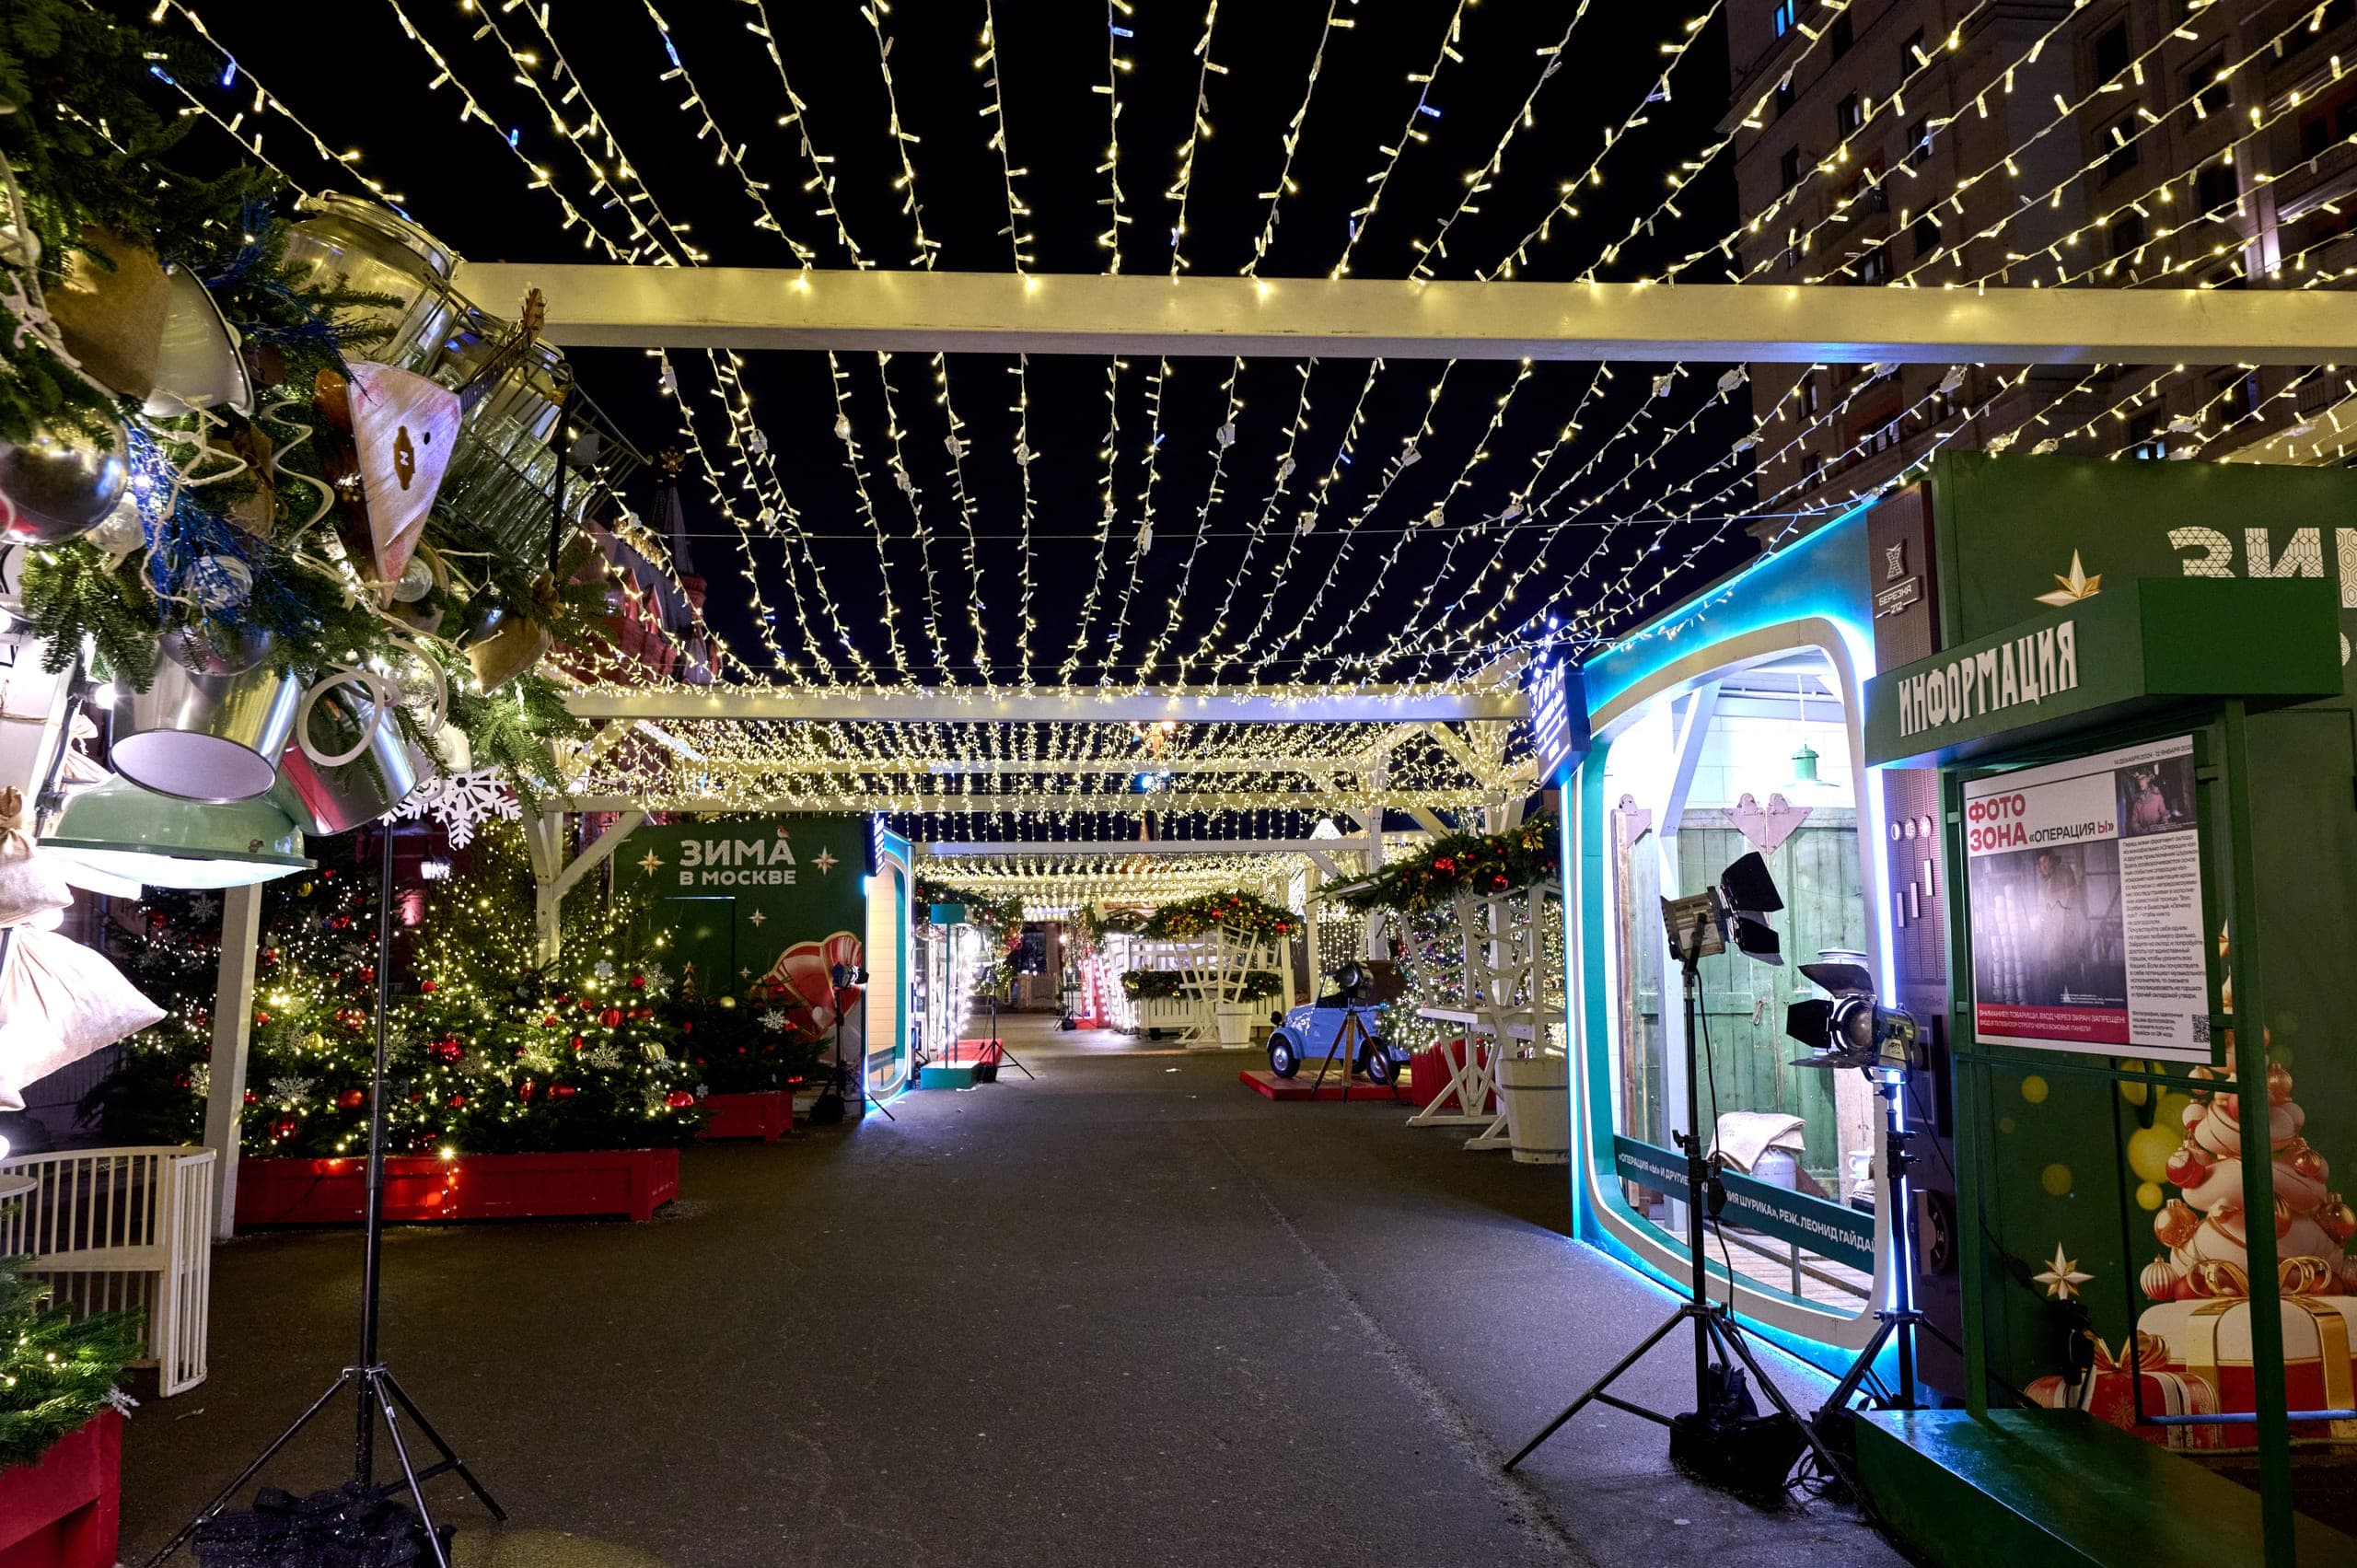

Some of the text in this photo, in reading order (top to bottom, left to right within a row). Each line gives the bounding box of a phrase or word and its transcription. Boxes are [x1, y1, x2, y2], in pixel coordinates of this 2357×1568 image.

[1878, 584, 1912, 606] БЕРЕЗКА
[1890, 601, 1903, 614] 212
[1898, 621, 2078, 737] ИНФОРМАЦИЯ
[1968, 794, 2026, 824] ФОТО
[1969, 821, 2028, 852] ЗОНА
[2029, 822, 2096, 844] «ОПЕРАЦИЯ
[679, 839, 796, 866] ЗИМА
[679, 870, 796, 886] В МОСКВЕ
[1619, 1153, 1649, 1171] «ОПЕРАЦИЯ
[1660, 1166, 1666, 1177] И
[1666, 1168, 1690, 1186] ДРУГИЕ
[1779, 1208, 1800, 1225] РЕЖ.
[1800, 1216, 1839, 1242] ЛЕОНИД
